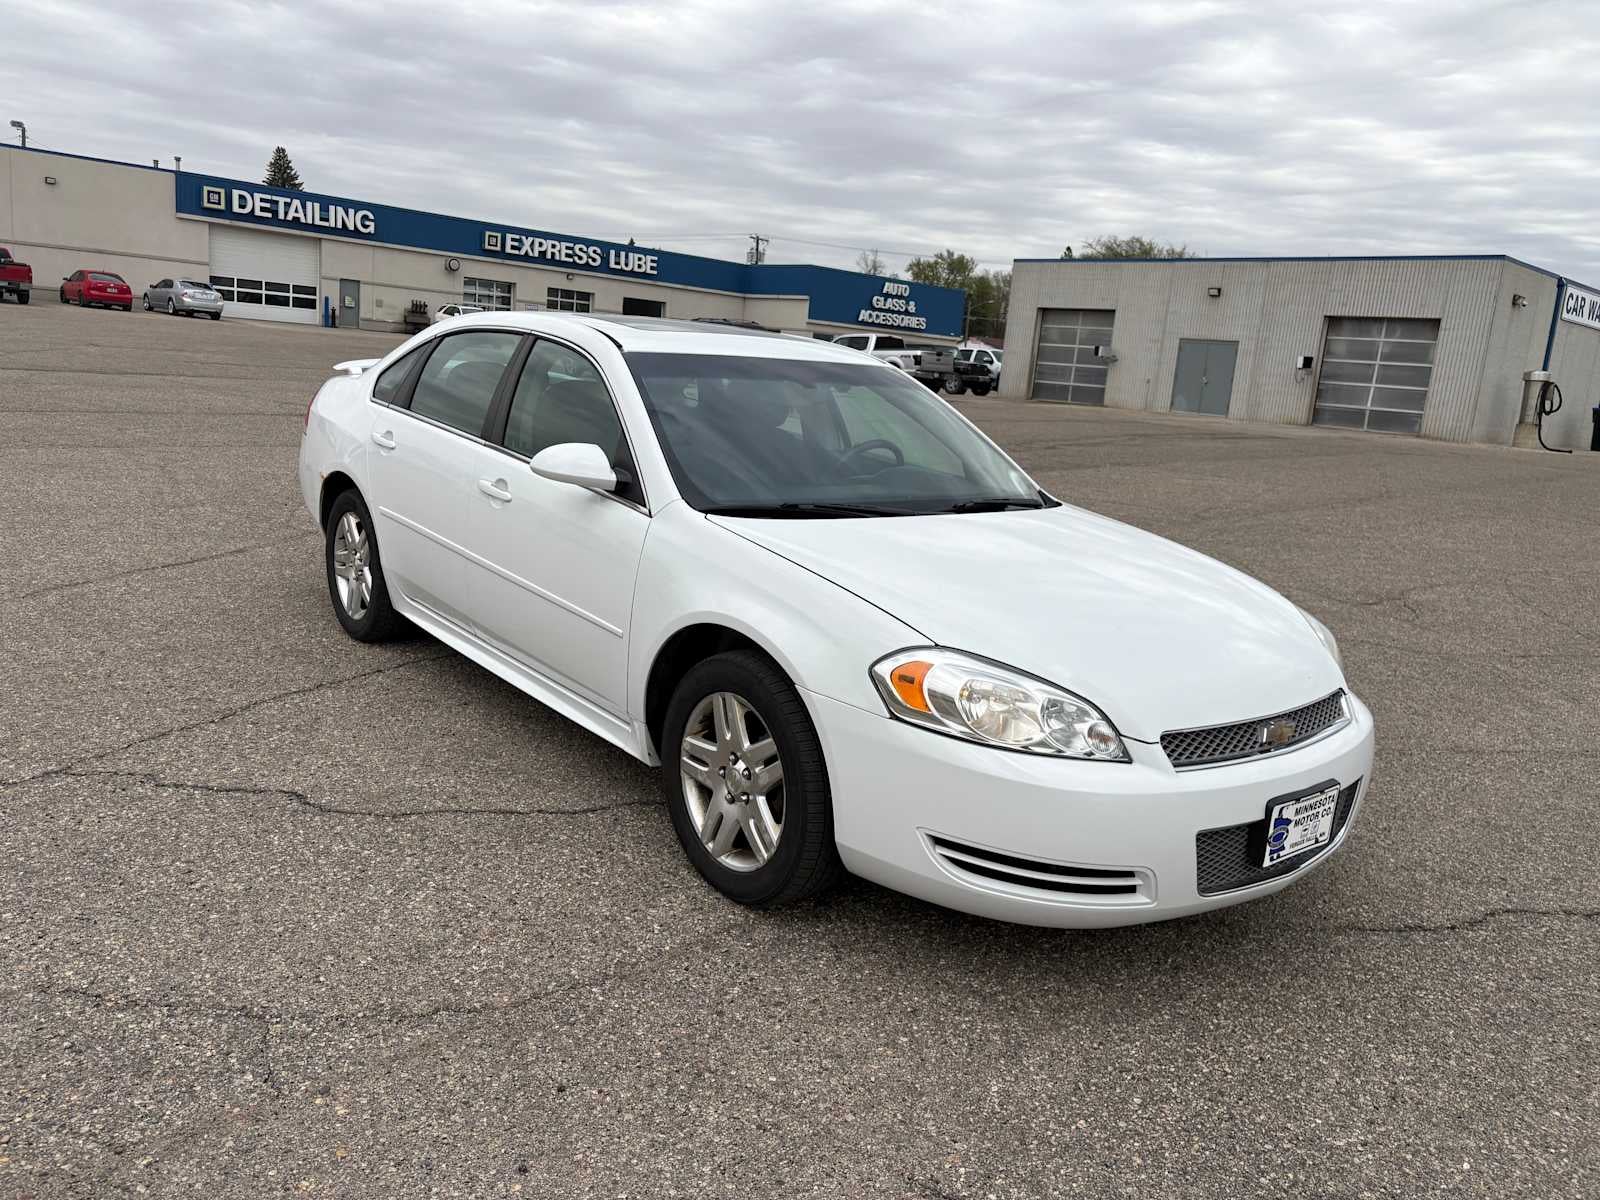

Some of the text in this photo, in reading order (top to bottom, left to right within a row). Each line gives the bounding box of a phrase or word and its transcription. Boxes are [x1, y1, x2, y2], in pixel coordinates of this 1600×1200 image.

[231, 188, 376, 235] DETAILING
[505, 233, 658, 275] EXPRESS LUBE
[883, 281, 910, 297] AUTO
[872, 295, 916, 313] GLASS &
[1566, 292, 1586, 318] CAR
[858, 309, 927, 330] ACCESSORIES
[1294, 793, 1336, 817] MINNESOTA
[1294, 811, 1321, 829] MOTOR
